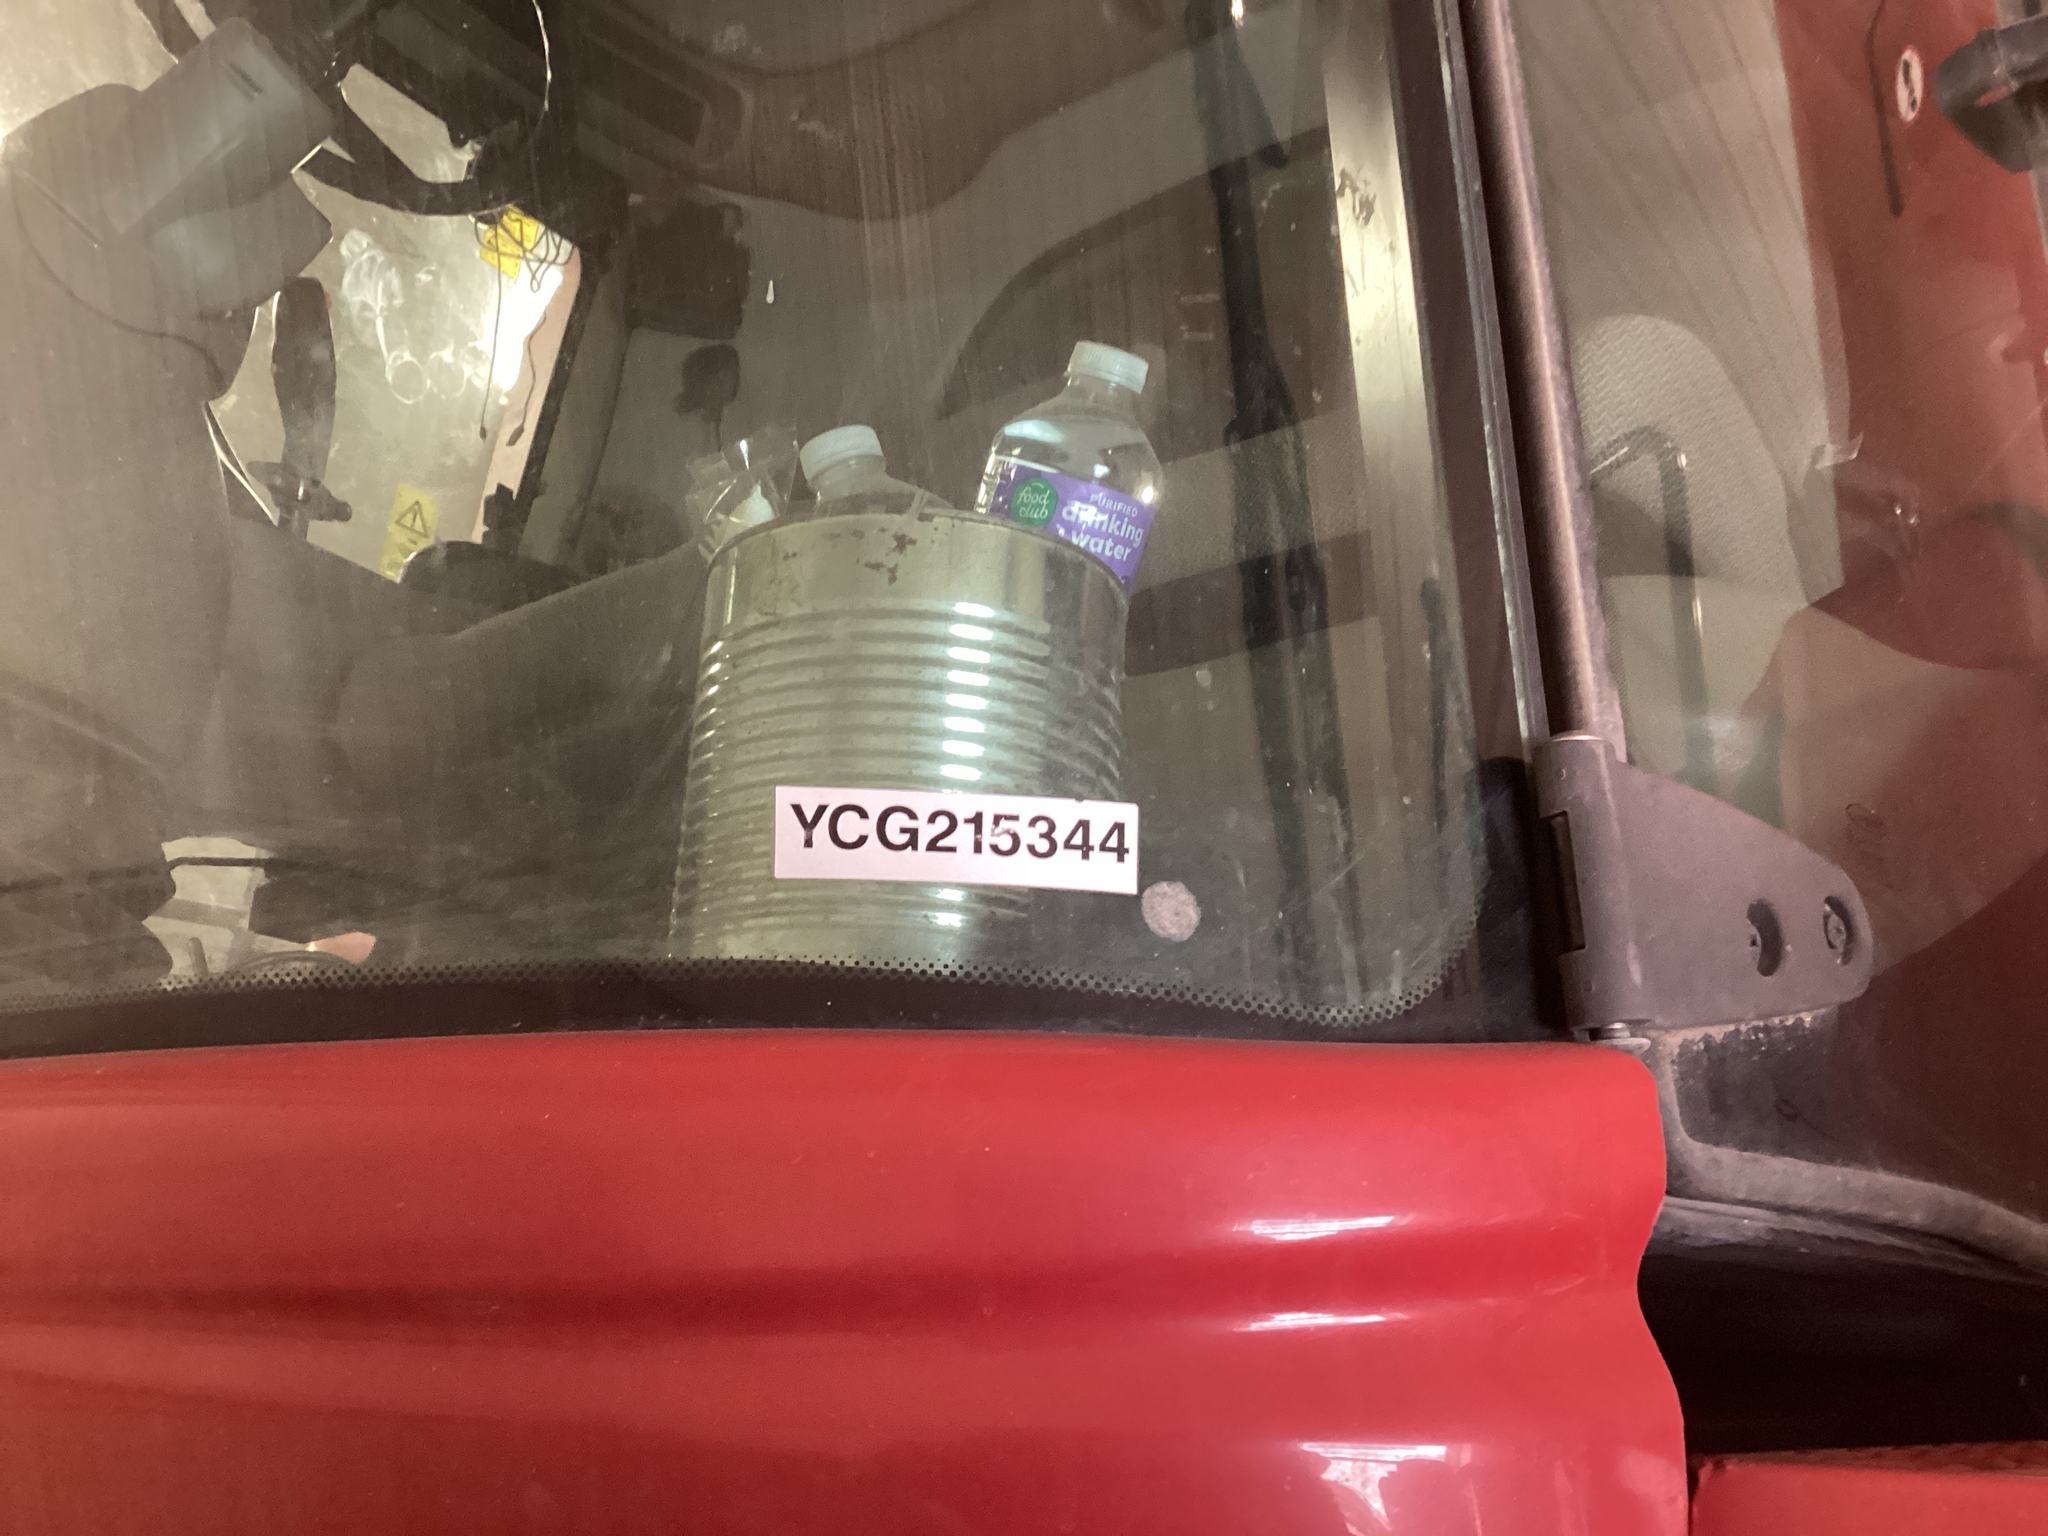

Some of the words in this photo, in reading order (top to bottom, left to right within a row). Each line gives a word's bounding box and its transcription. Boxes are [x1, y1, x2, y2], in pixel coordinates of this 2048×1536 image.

[1019, 486, 1050, 505] food
[1090, 492, 1138, 517] PURIFIED
[1019, 504, 1049, 519] club
[1071, 530, 1132, 562] water
[790, 803, 1130, 864] YCG215344
